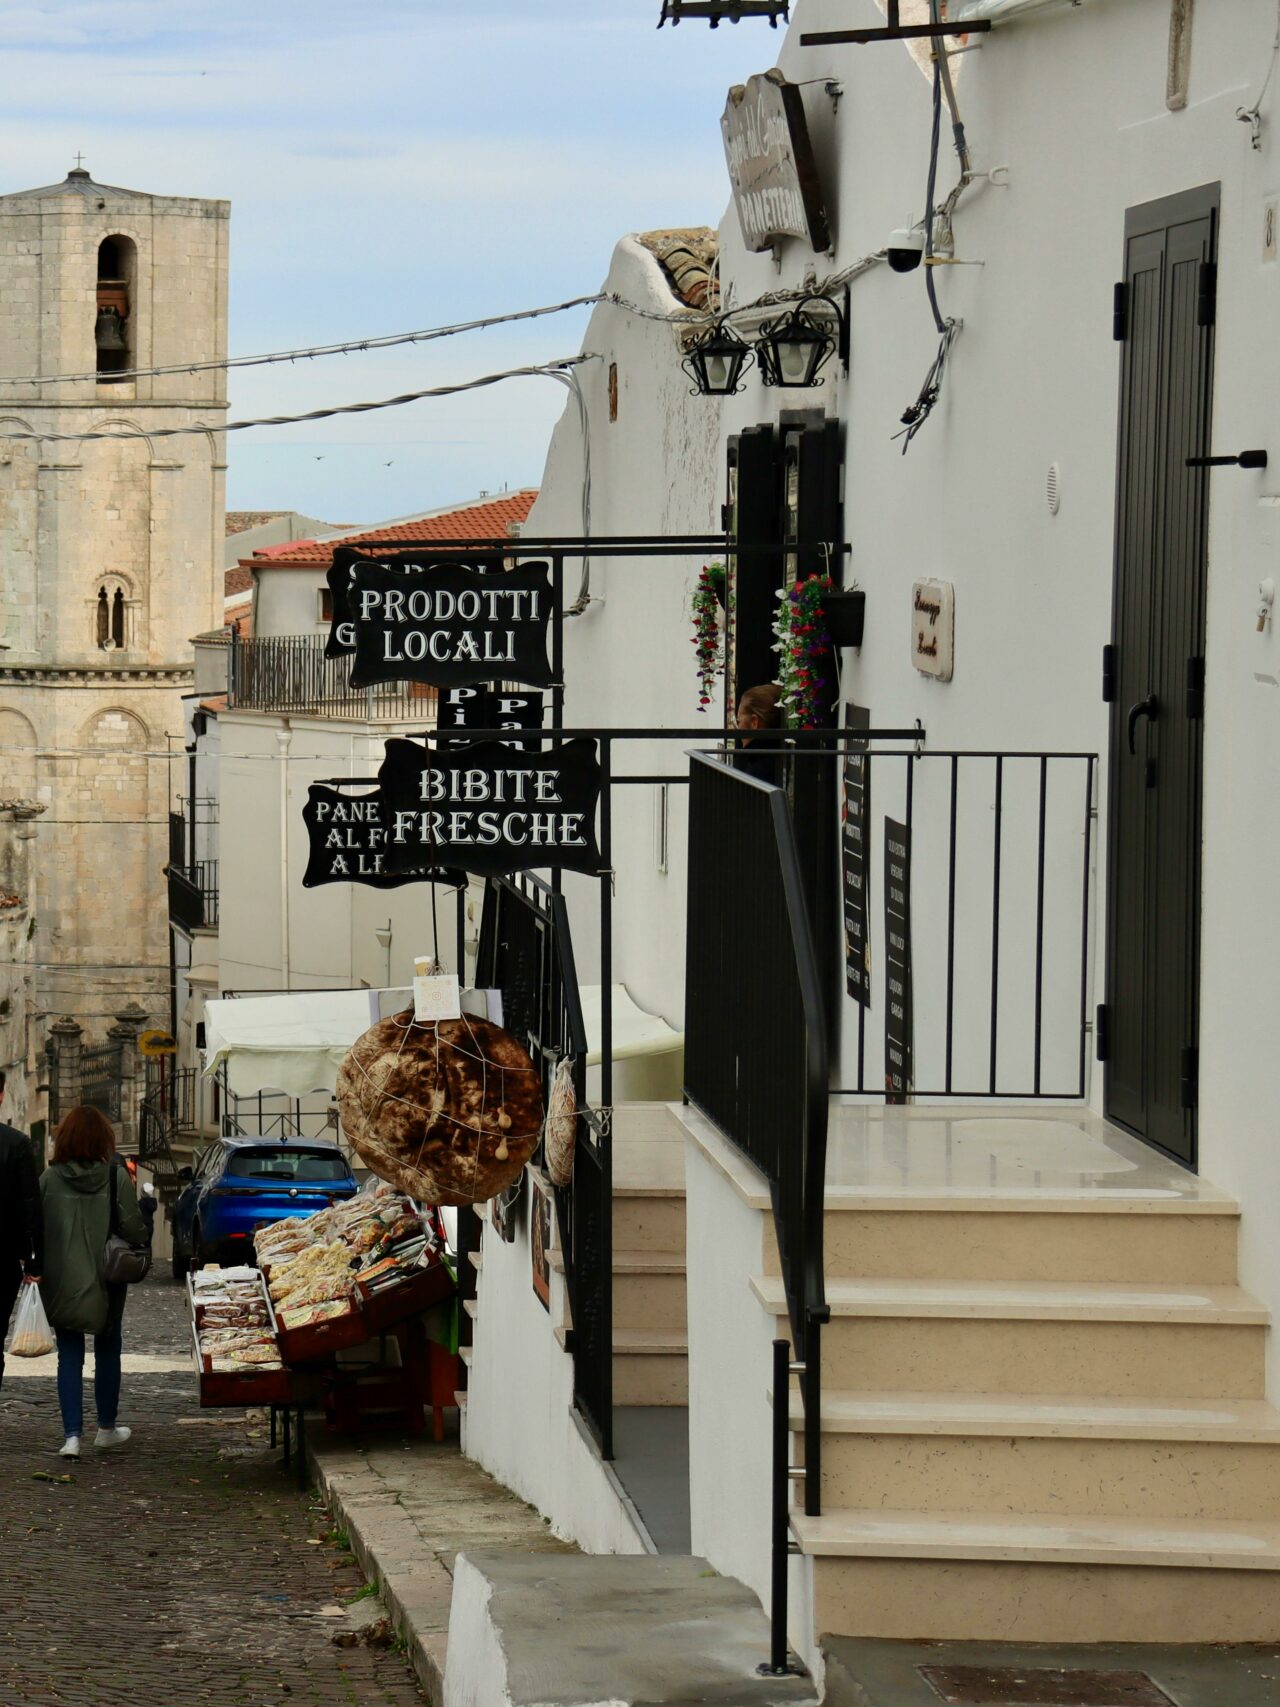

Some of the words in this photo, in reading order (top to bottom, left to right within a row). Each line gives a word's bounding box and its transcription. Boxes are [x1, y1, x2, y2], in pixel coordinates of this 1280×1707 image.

[360, 590, 540, 623] PRODOTTI
[383, 630, 516, 662] LOCALI
[419, 768, 562, 802] BIBITE
[316, 802, 381, 822] PANE
[325, 828, 361, 848] AL
[393, 811, 587, 846] FRESCHE
[330, 854, 350, 875] A
